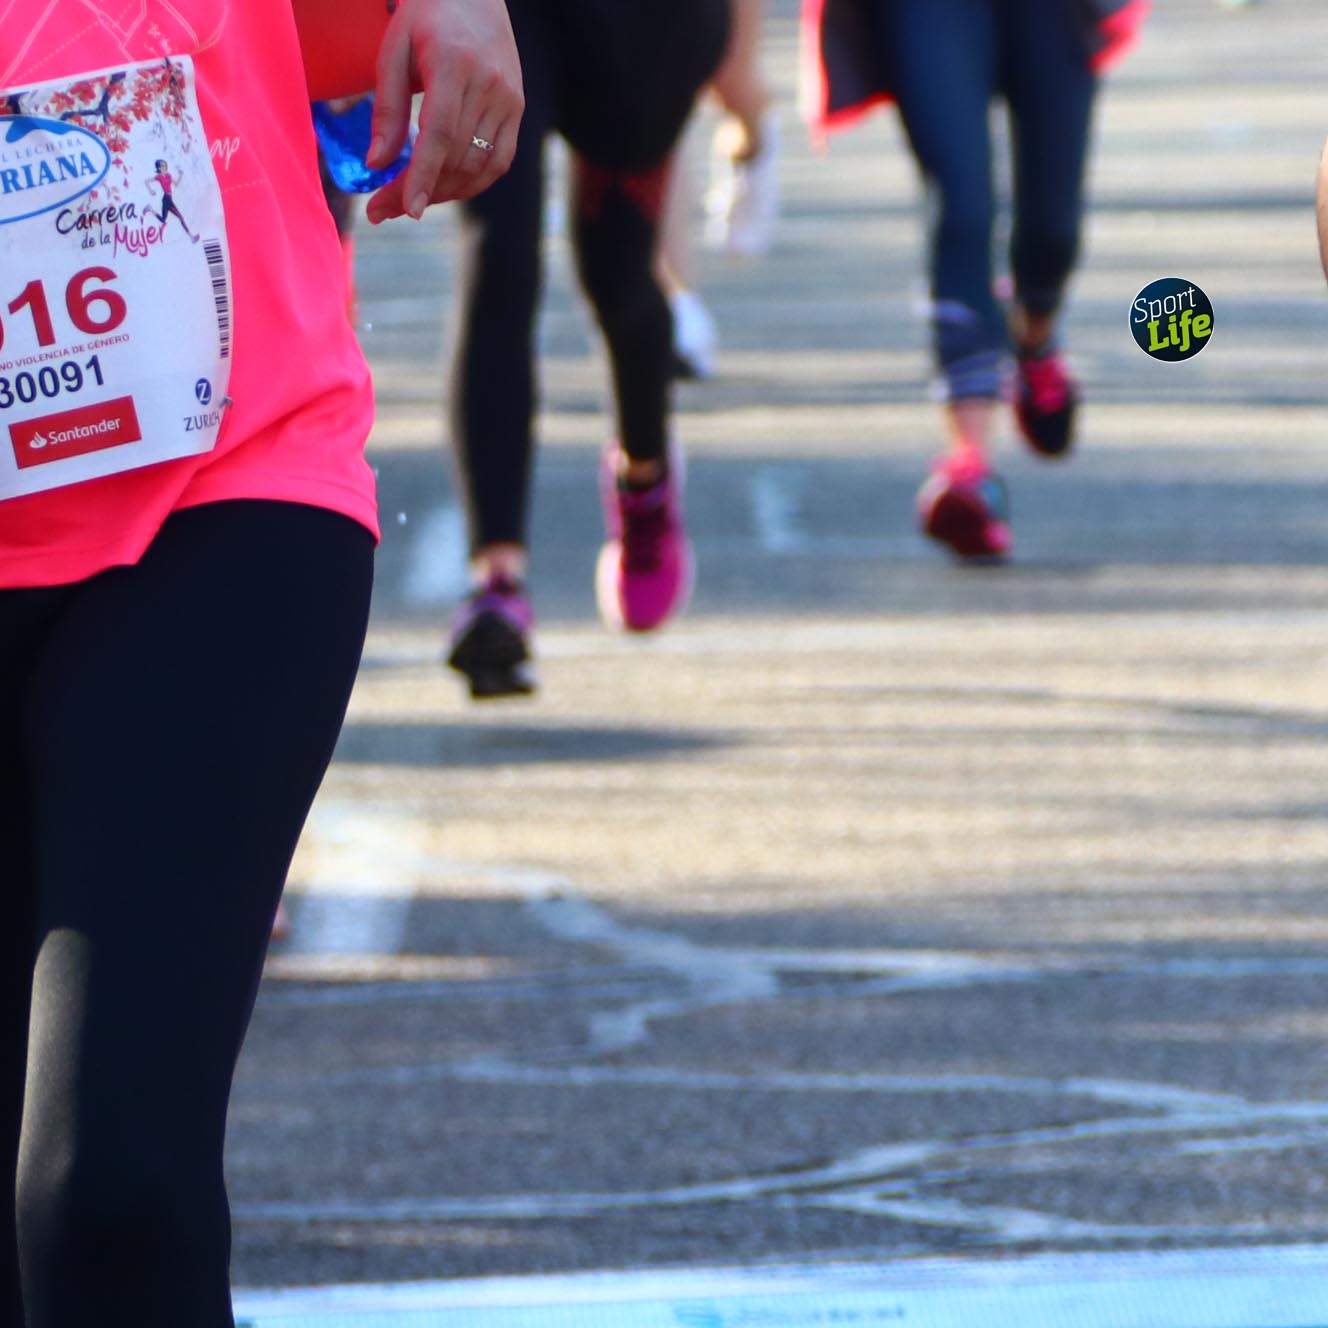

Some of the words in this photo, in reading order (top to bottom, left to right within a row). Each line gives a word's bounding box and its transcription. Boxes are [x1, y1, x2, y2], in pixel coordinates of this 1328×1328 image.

[15, 138, 83, 162] LECHERA
[56, 202, 137, 234] Carrera
[81, 232, 96, 249] de
[99, 228, 112, 244] la
[113, 217, 167, 258] Mujer
[15, 348, 70, 368] VIOLENCIA
[72, 344, 85, 354] DE
[48, 417, 121, 445] Santander
[184, 412, 221, 432] ZURICH
